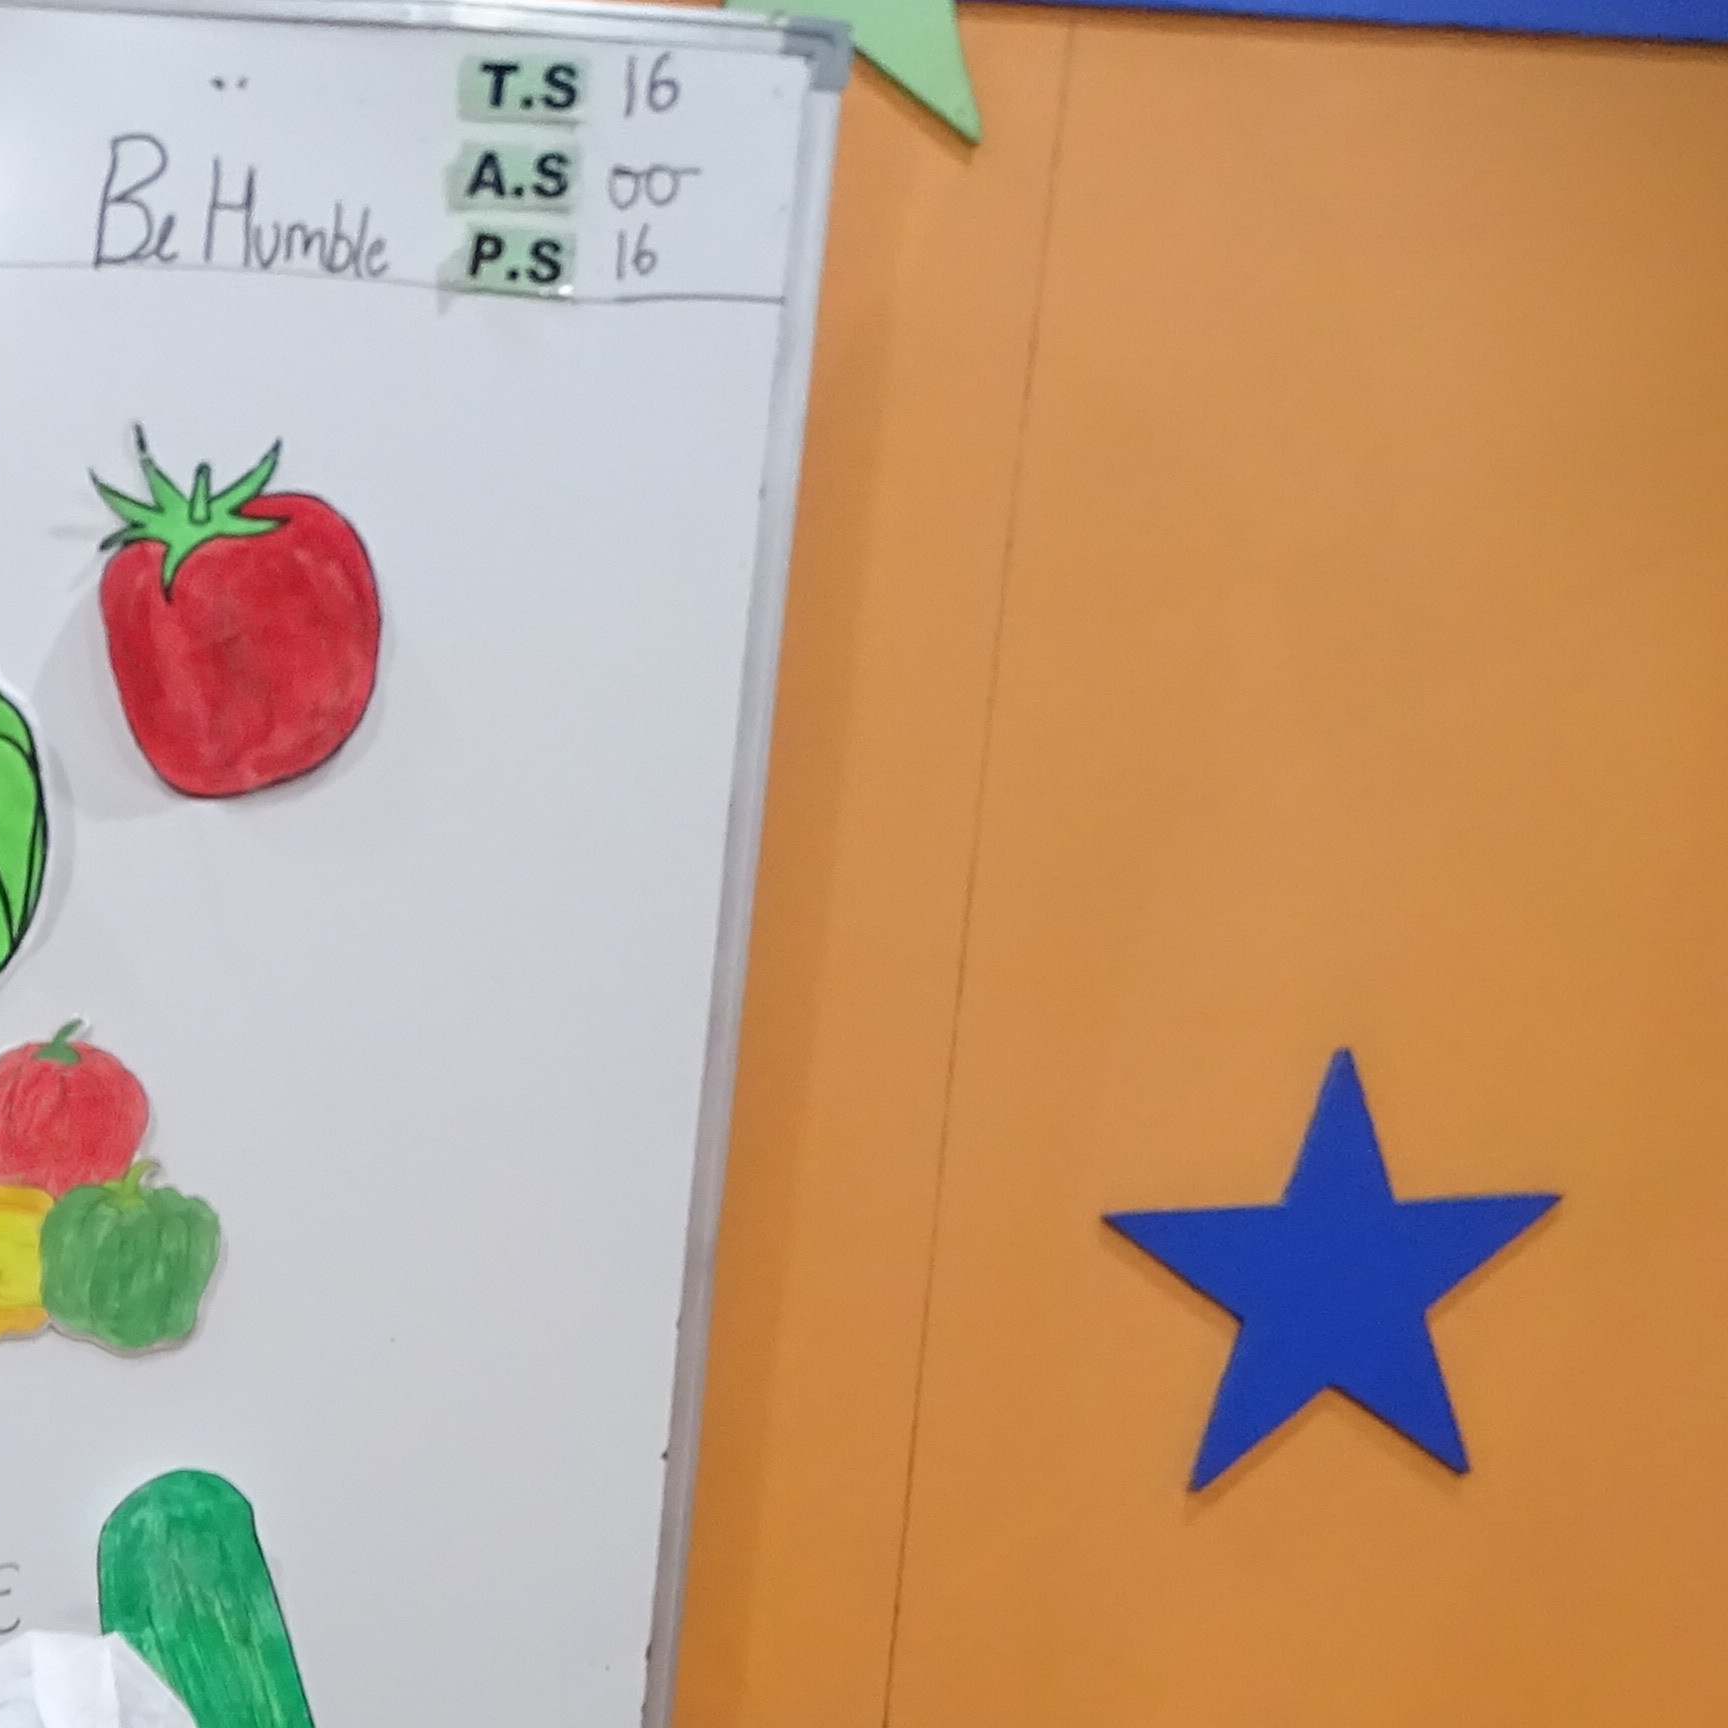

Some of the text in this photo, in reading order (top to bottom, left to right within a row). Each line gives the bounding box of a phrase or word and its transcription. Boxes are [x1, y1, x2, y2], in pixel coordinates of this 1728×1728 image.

[480, 52, 682, 117] T.S 16
[91, 132, 390, 280] Be Humble
[465, 151, 570, 203] A.S
[467, 223, 658, 284] P.S 16
